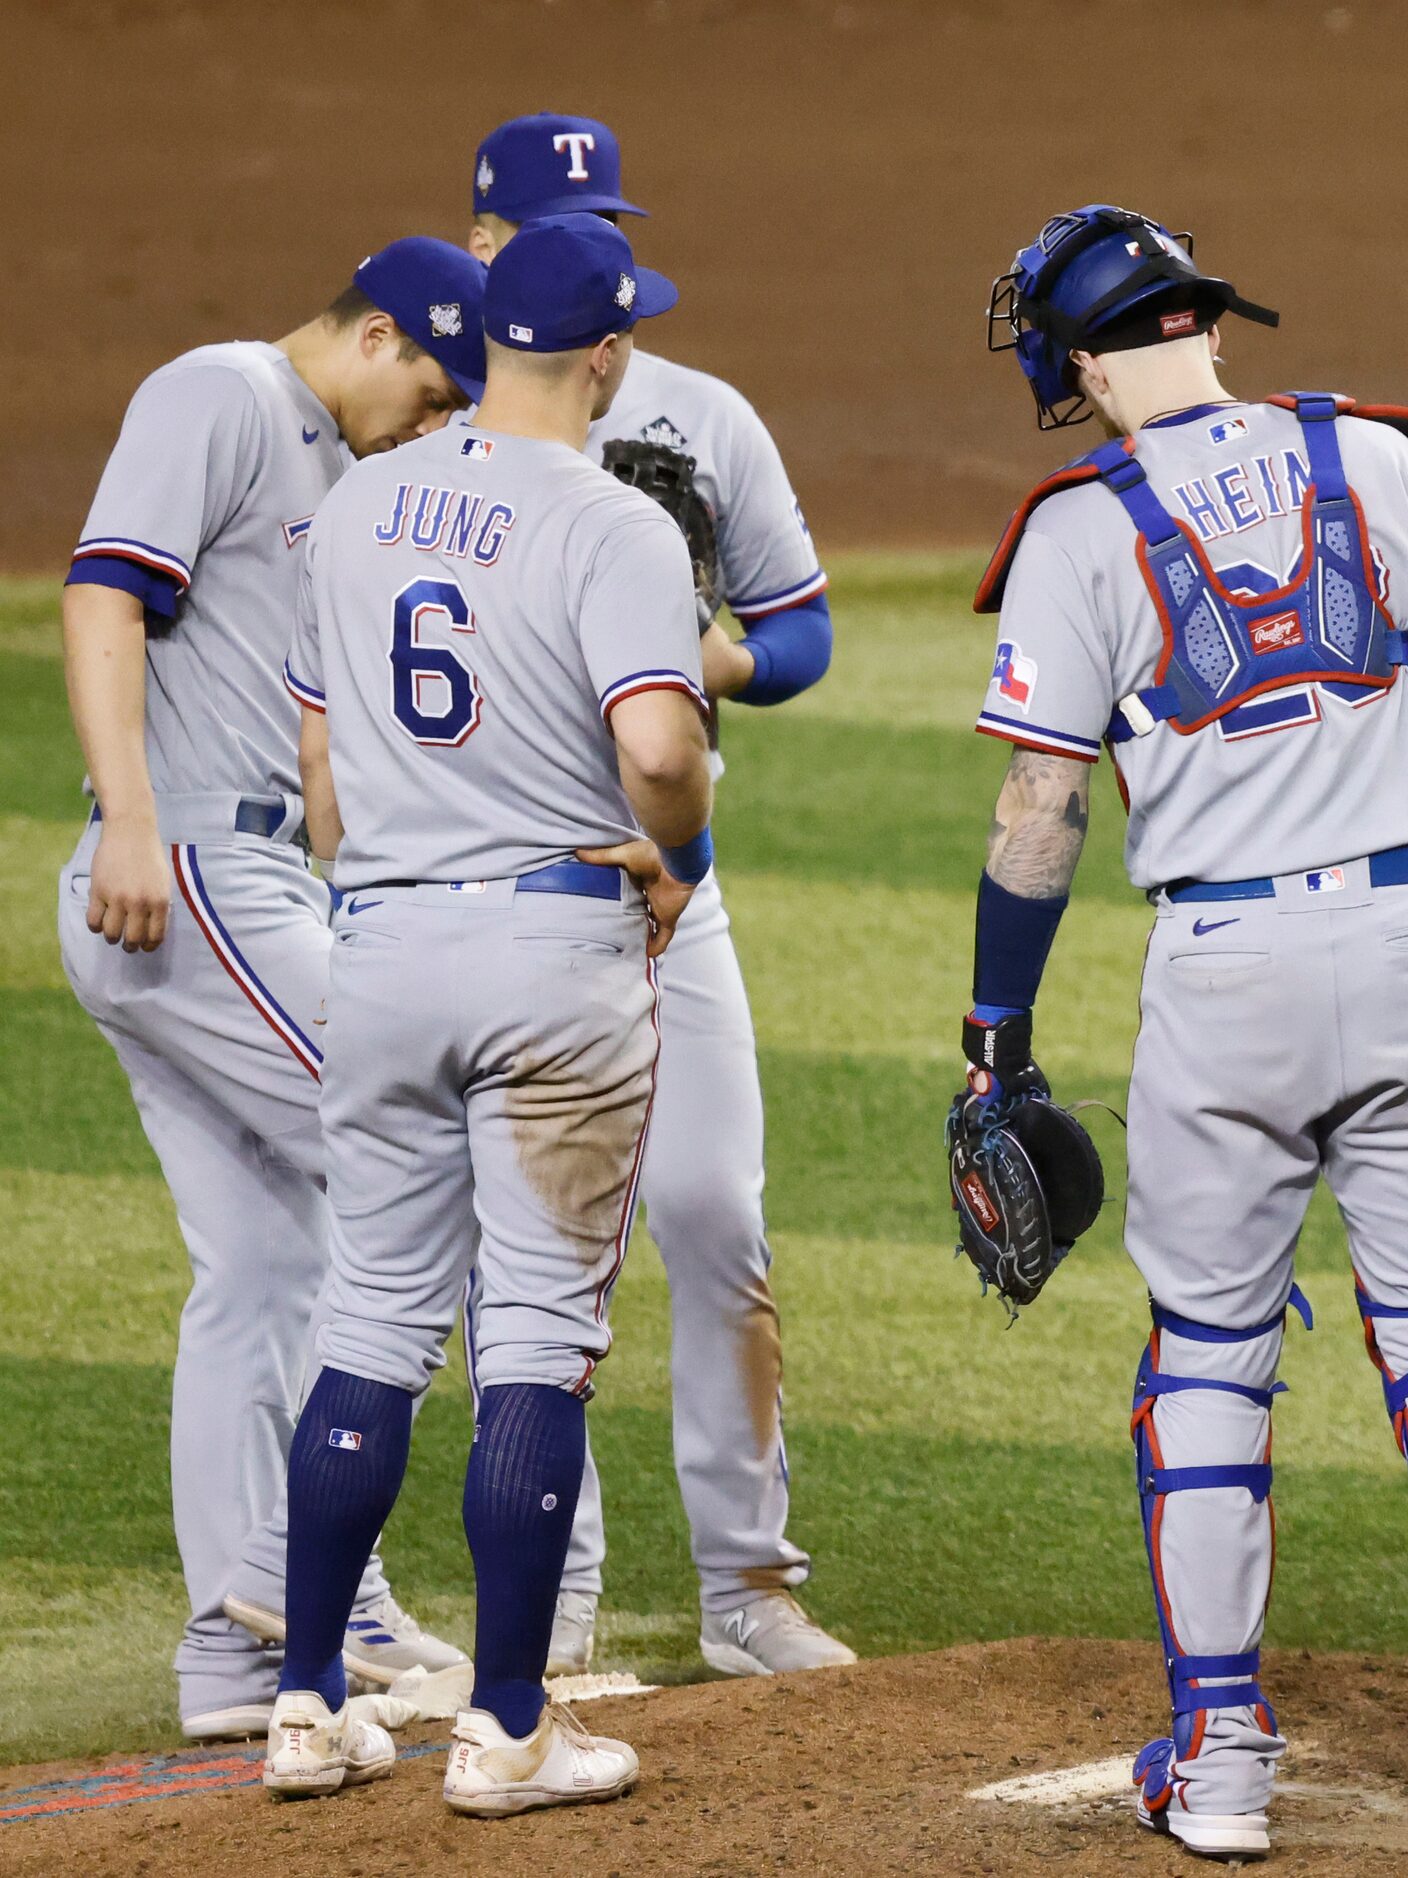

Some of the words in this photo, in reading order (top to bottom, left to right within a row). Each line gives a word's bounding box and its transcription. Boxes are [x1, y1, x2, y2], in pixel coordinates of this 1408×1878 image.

[553, 133, 594, 181] T
[373, 483, 515, 567] JUNG
[1255, 620, 1296, 644] Rawlings
[385, 575, 484, 748] 6
[983, 1029, 997, 1067] ALL-STAR
